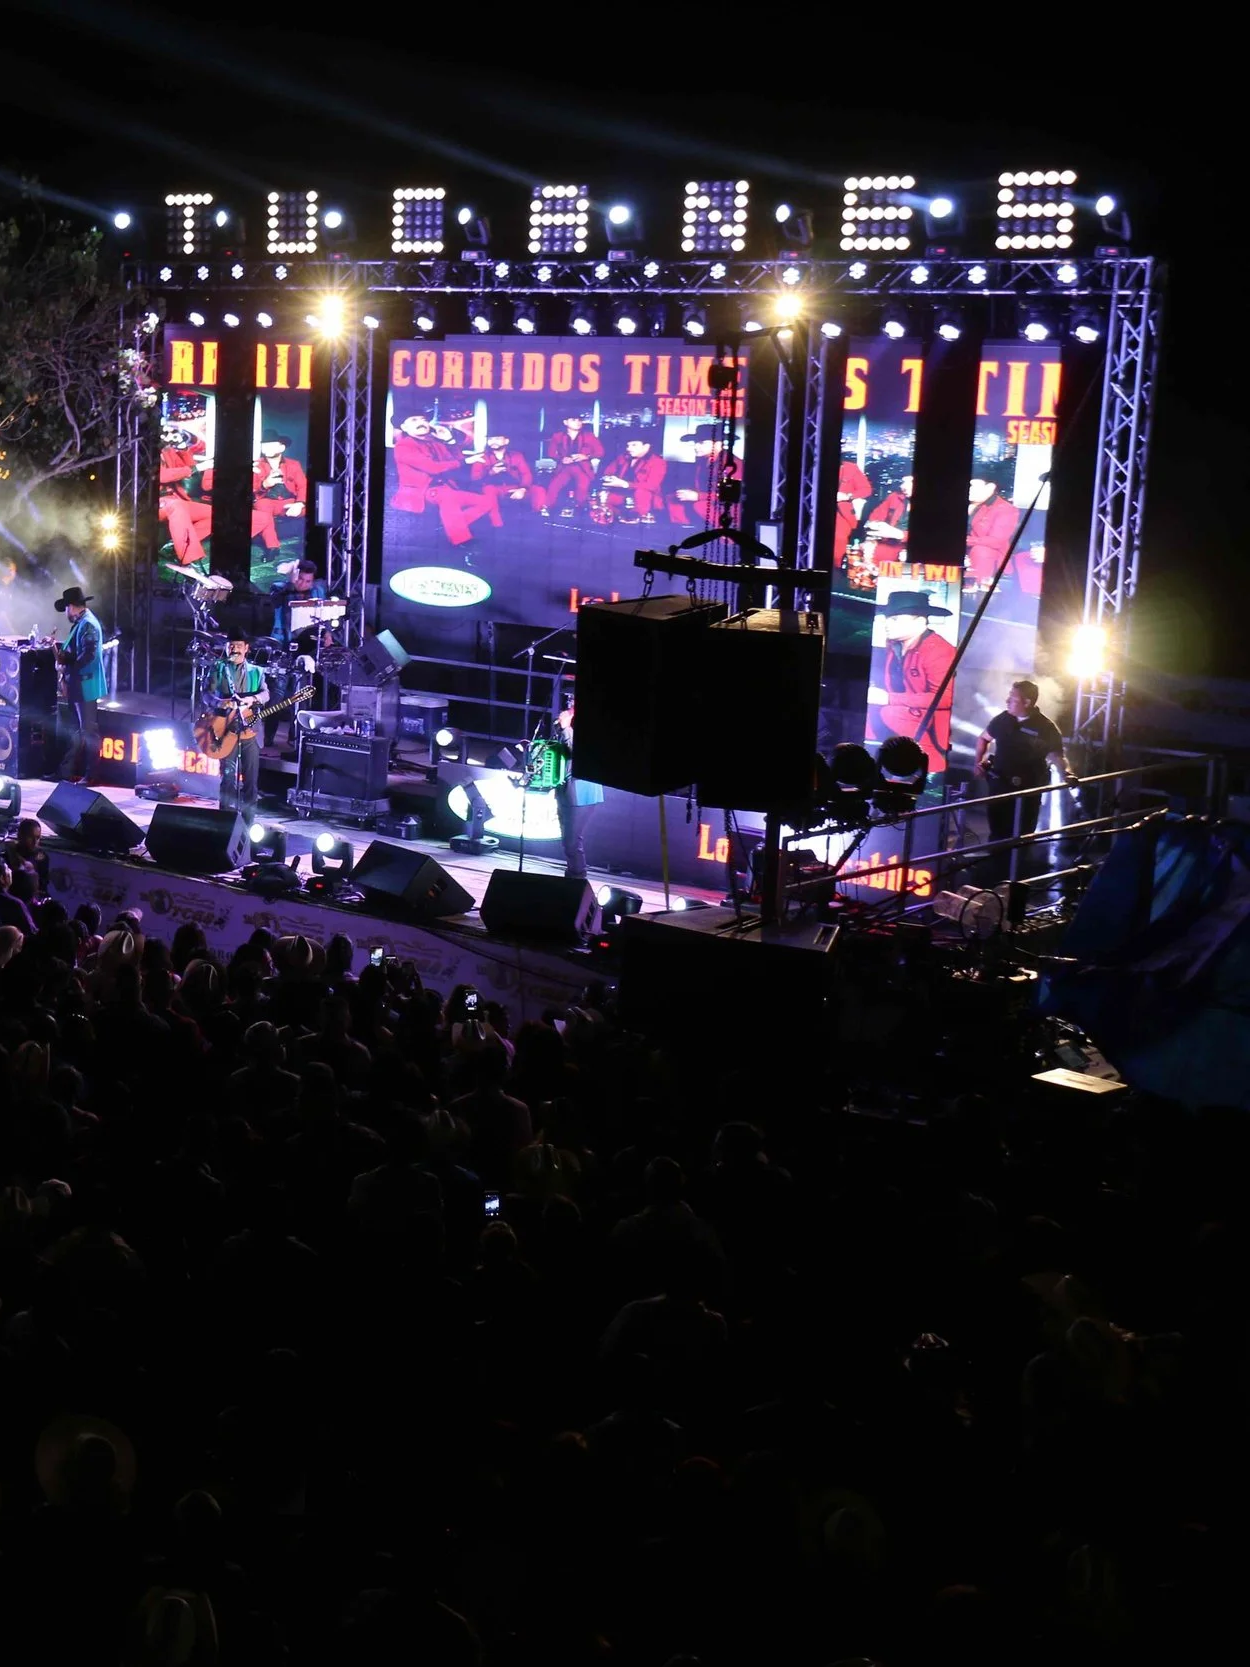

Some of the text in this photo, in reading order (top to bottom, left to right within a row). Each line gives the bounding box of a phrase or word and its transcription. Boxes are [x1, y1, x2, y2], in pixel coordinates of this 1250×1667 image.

[391, 350, 602, 394] CORRIDOS
[656, 397, 707, 417] SEASON
[1007, 420, 1058, 446] SEAS
